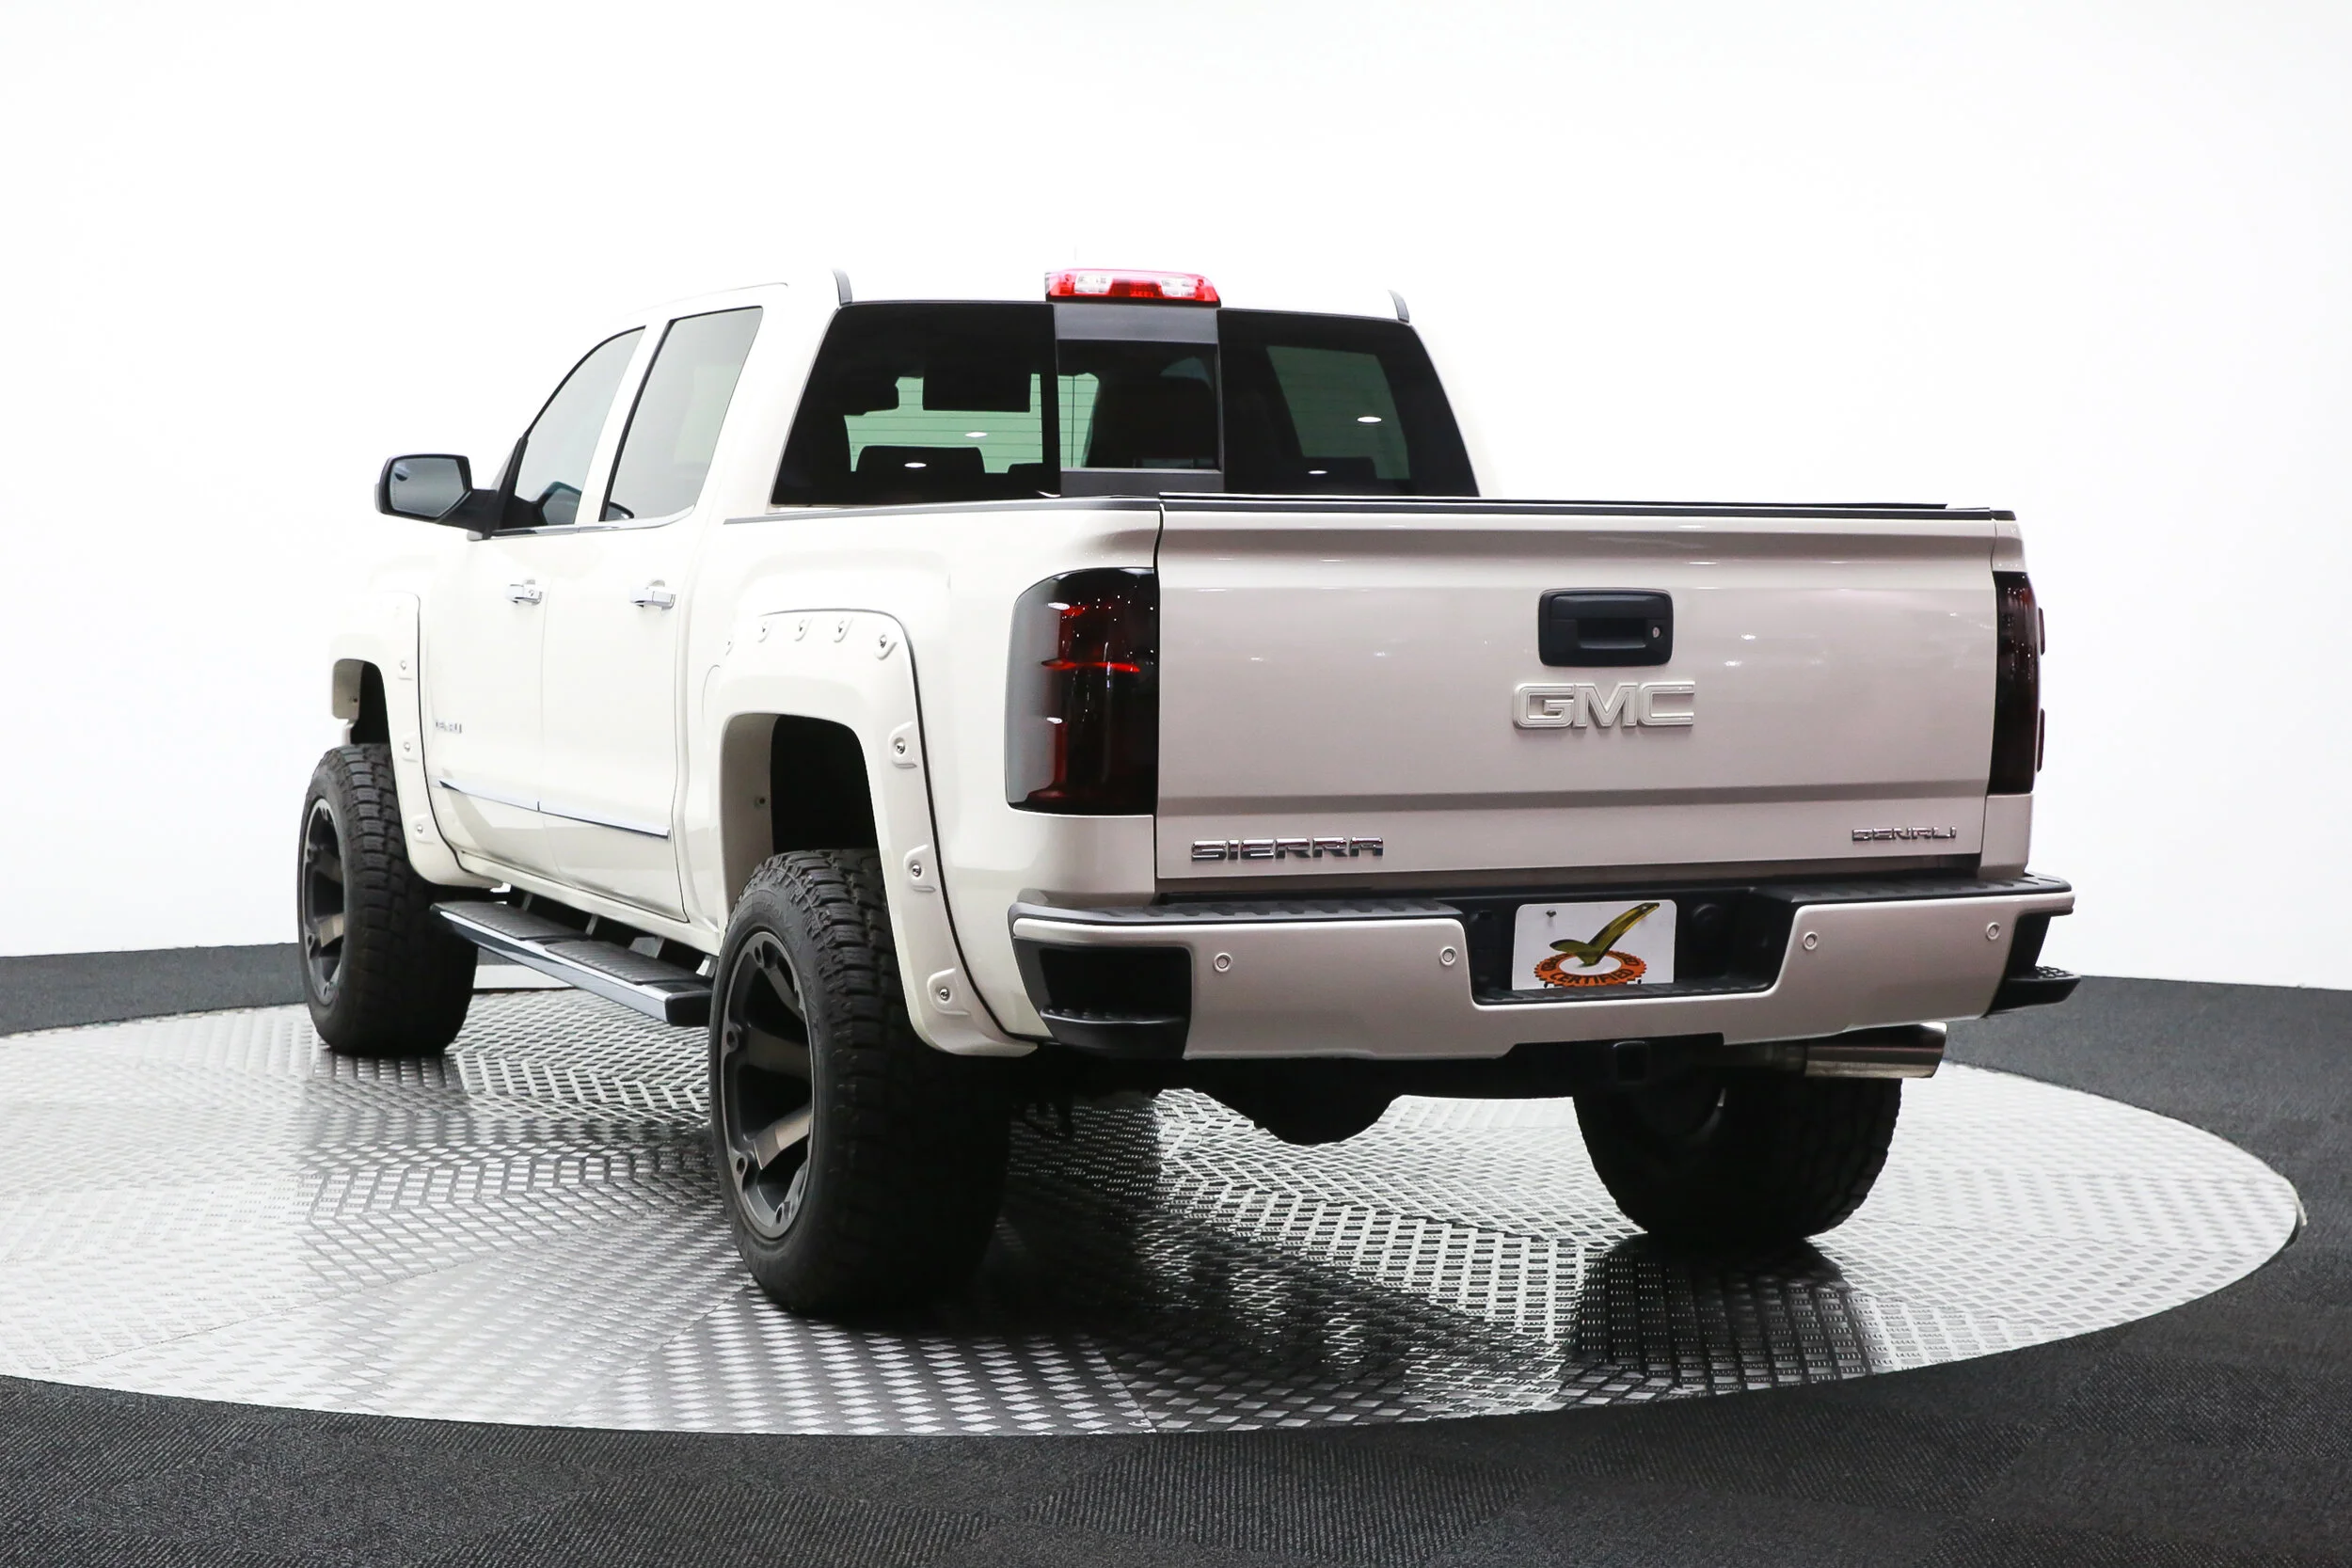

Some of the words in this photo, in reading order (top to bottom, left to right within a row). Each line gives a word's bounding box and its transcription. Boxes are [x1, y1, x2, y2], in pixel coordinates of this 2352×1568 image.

[1513, 681, 1694, 728] GMC
[1851, 826, 1958, 842] DENALI
[1191, 837, 1384, 862] SIERRA
[1550, 969, 1635, 985] CERTIFIED
